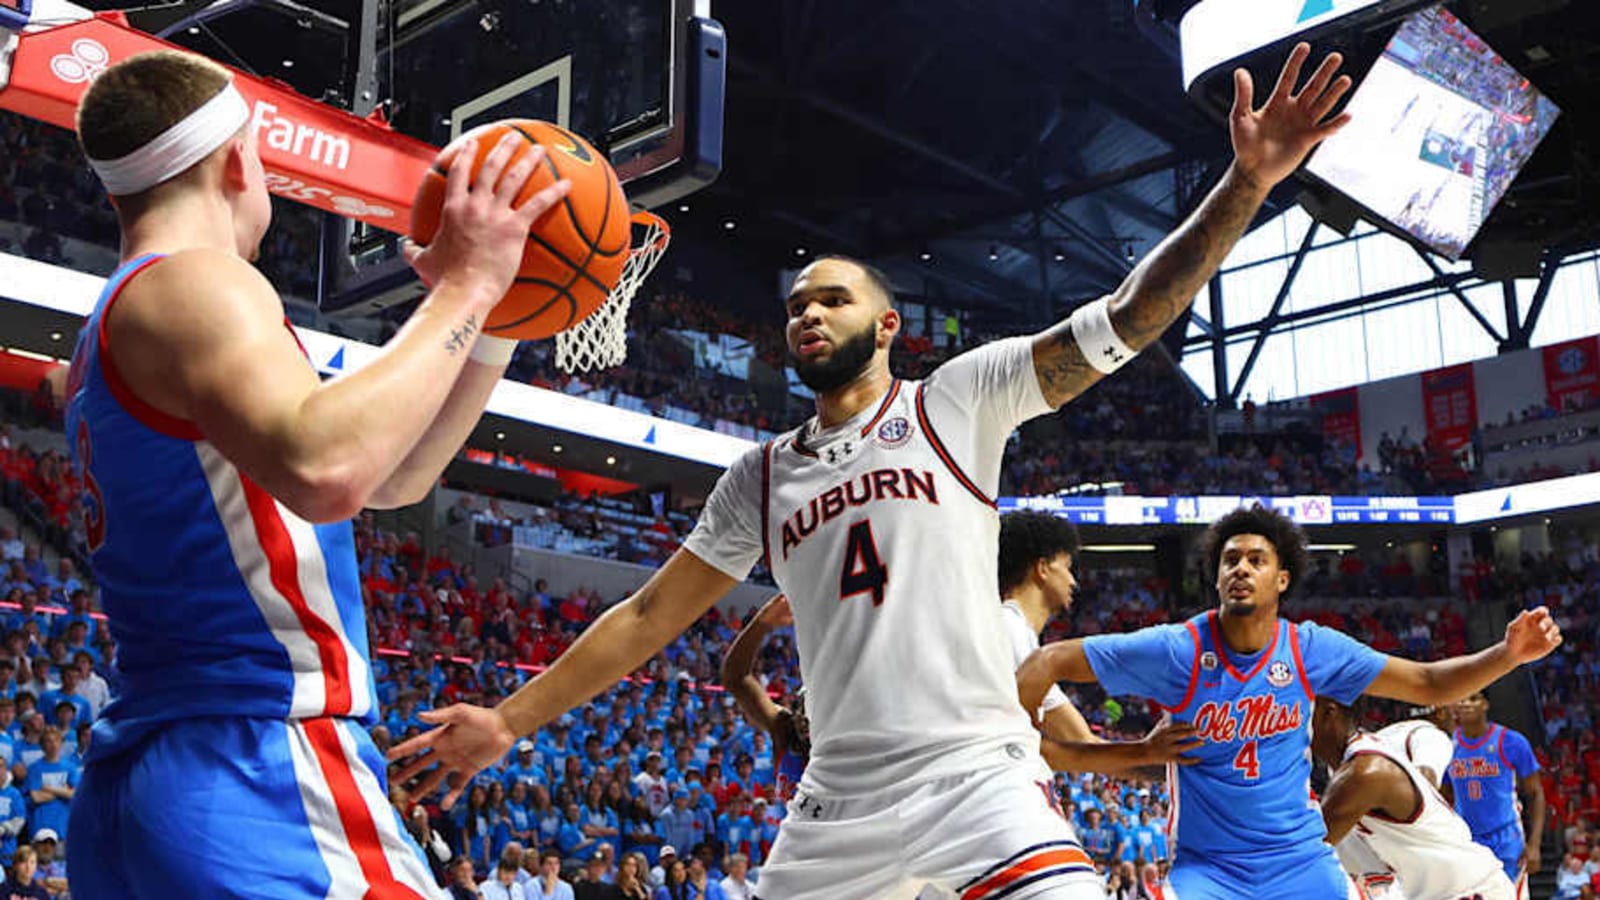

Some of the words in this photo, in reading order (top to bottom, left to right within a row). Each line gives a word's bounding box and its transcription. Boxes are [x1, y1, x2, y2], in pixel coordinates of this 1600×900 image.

[251, 100, 350, 170] Farm
[780, 468, 940, 561] AUBURN
[839, 516, 889, 608] 4
[1194, 701, 1237, 742] Ole
[1236, 692, 1301, 739] Miss
[1233, 740, 1260, 780] 4
